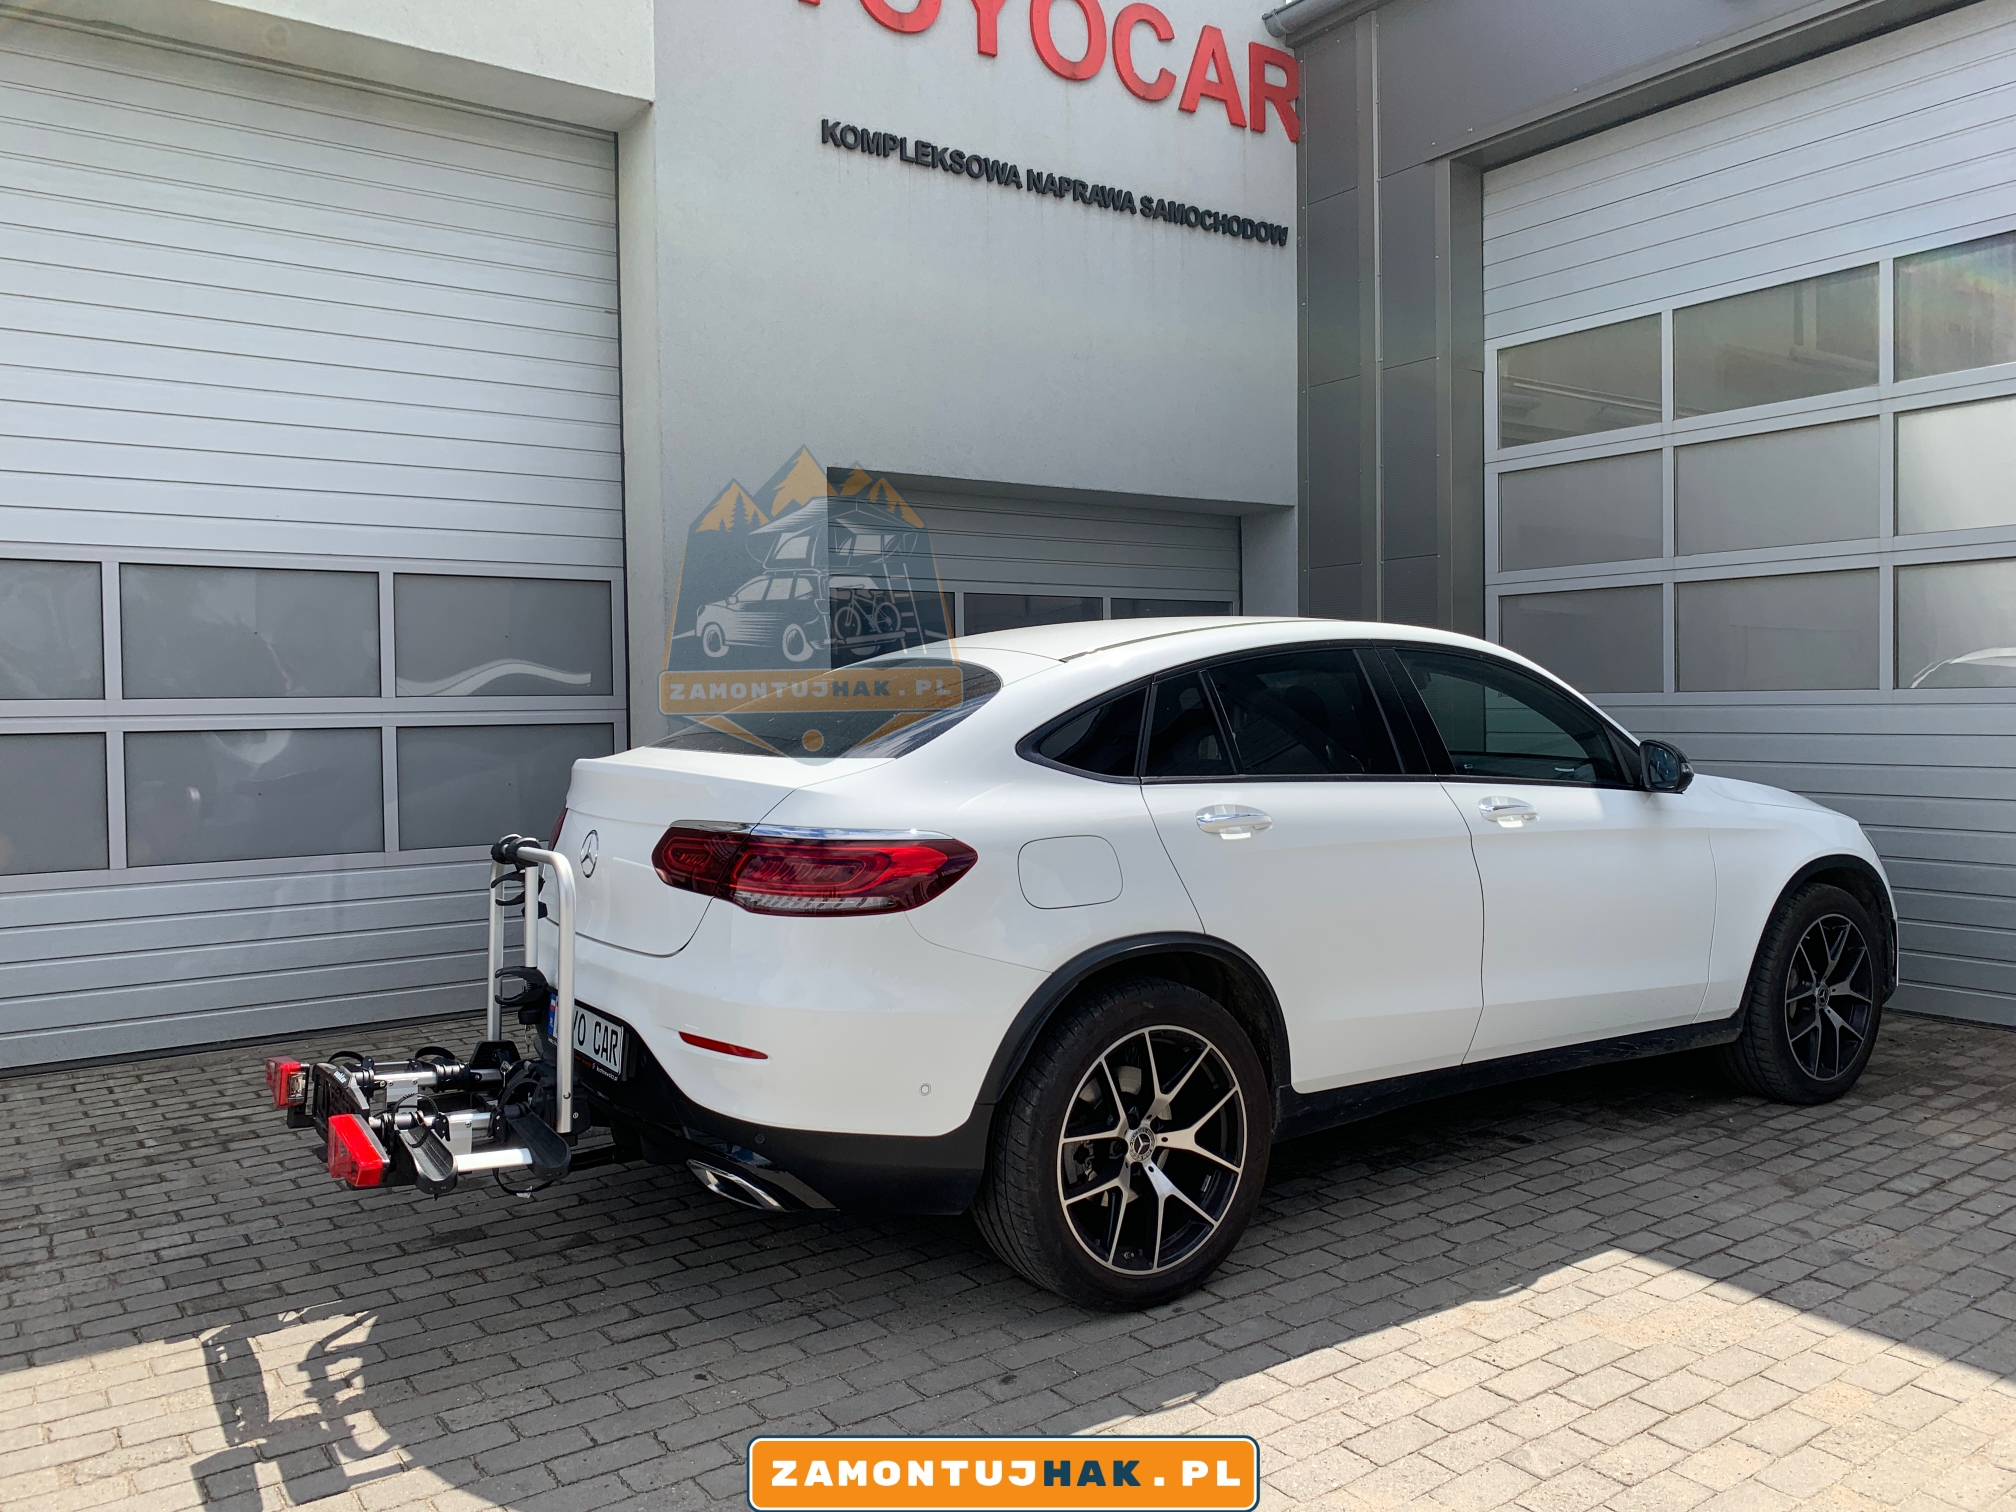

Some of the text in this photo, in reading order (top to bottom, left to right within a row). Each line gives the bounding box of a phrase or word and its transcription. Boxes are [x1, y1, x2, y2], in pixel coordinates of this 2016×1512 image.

[798, 0, 1301, 142] YOCAR
[821, 118, 1022, 189] KOMPLEKSOWA
[1026, 168, 1136, 214] NAPRAWA
[593, 1020, 618, 1067] CAR
